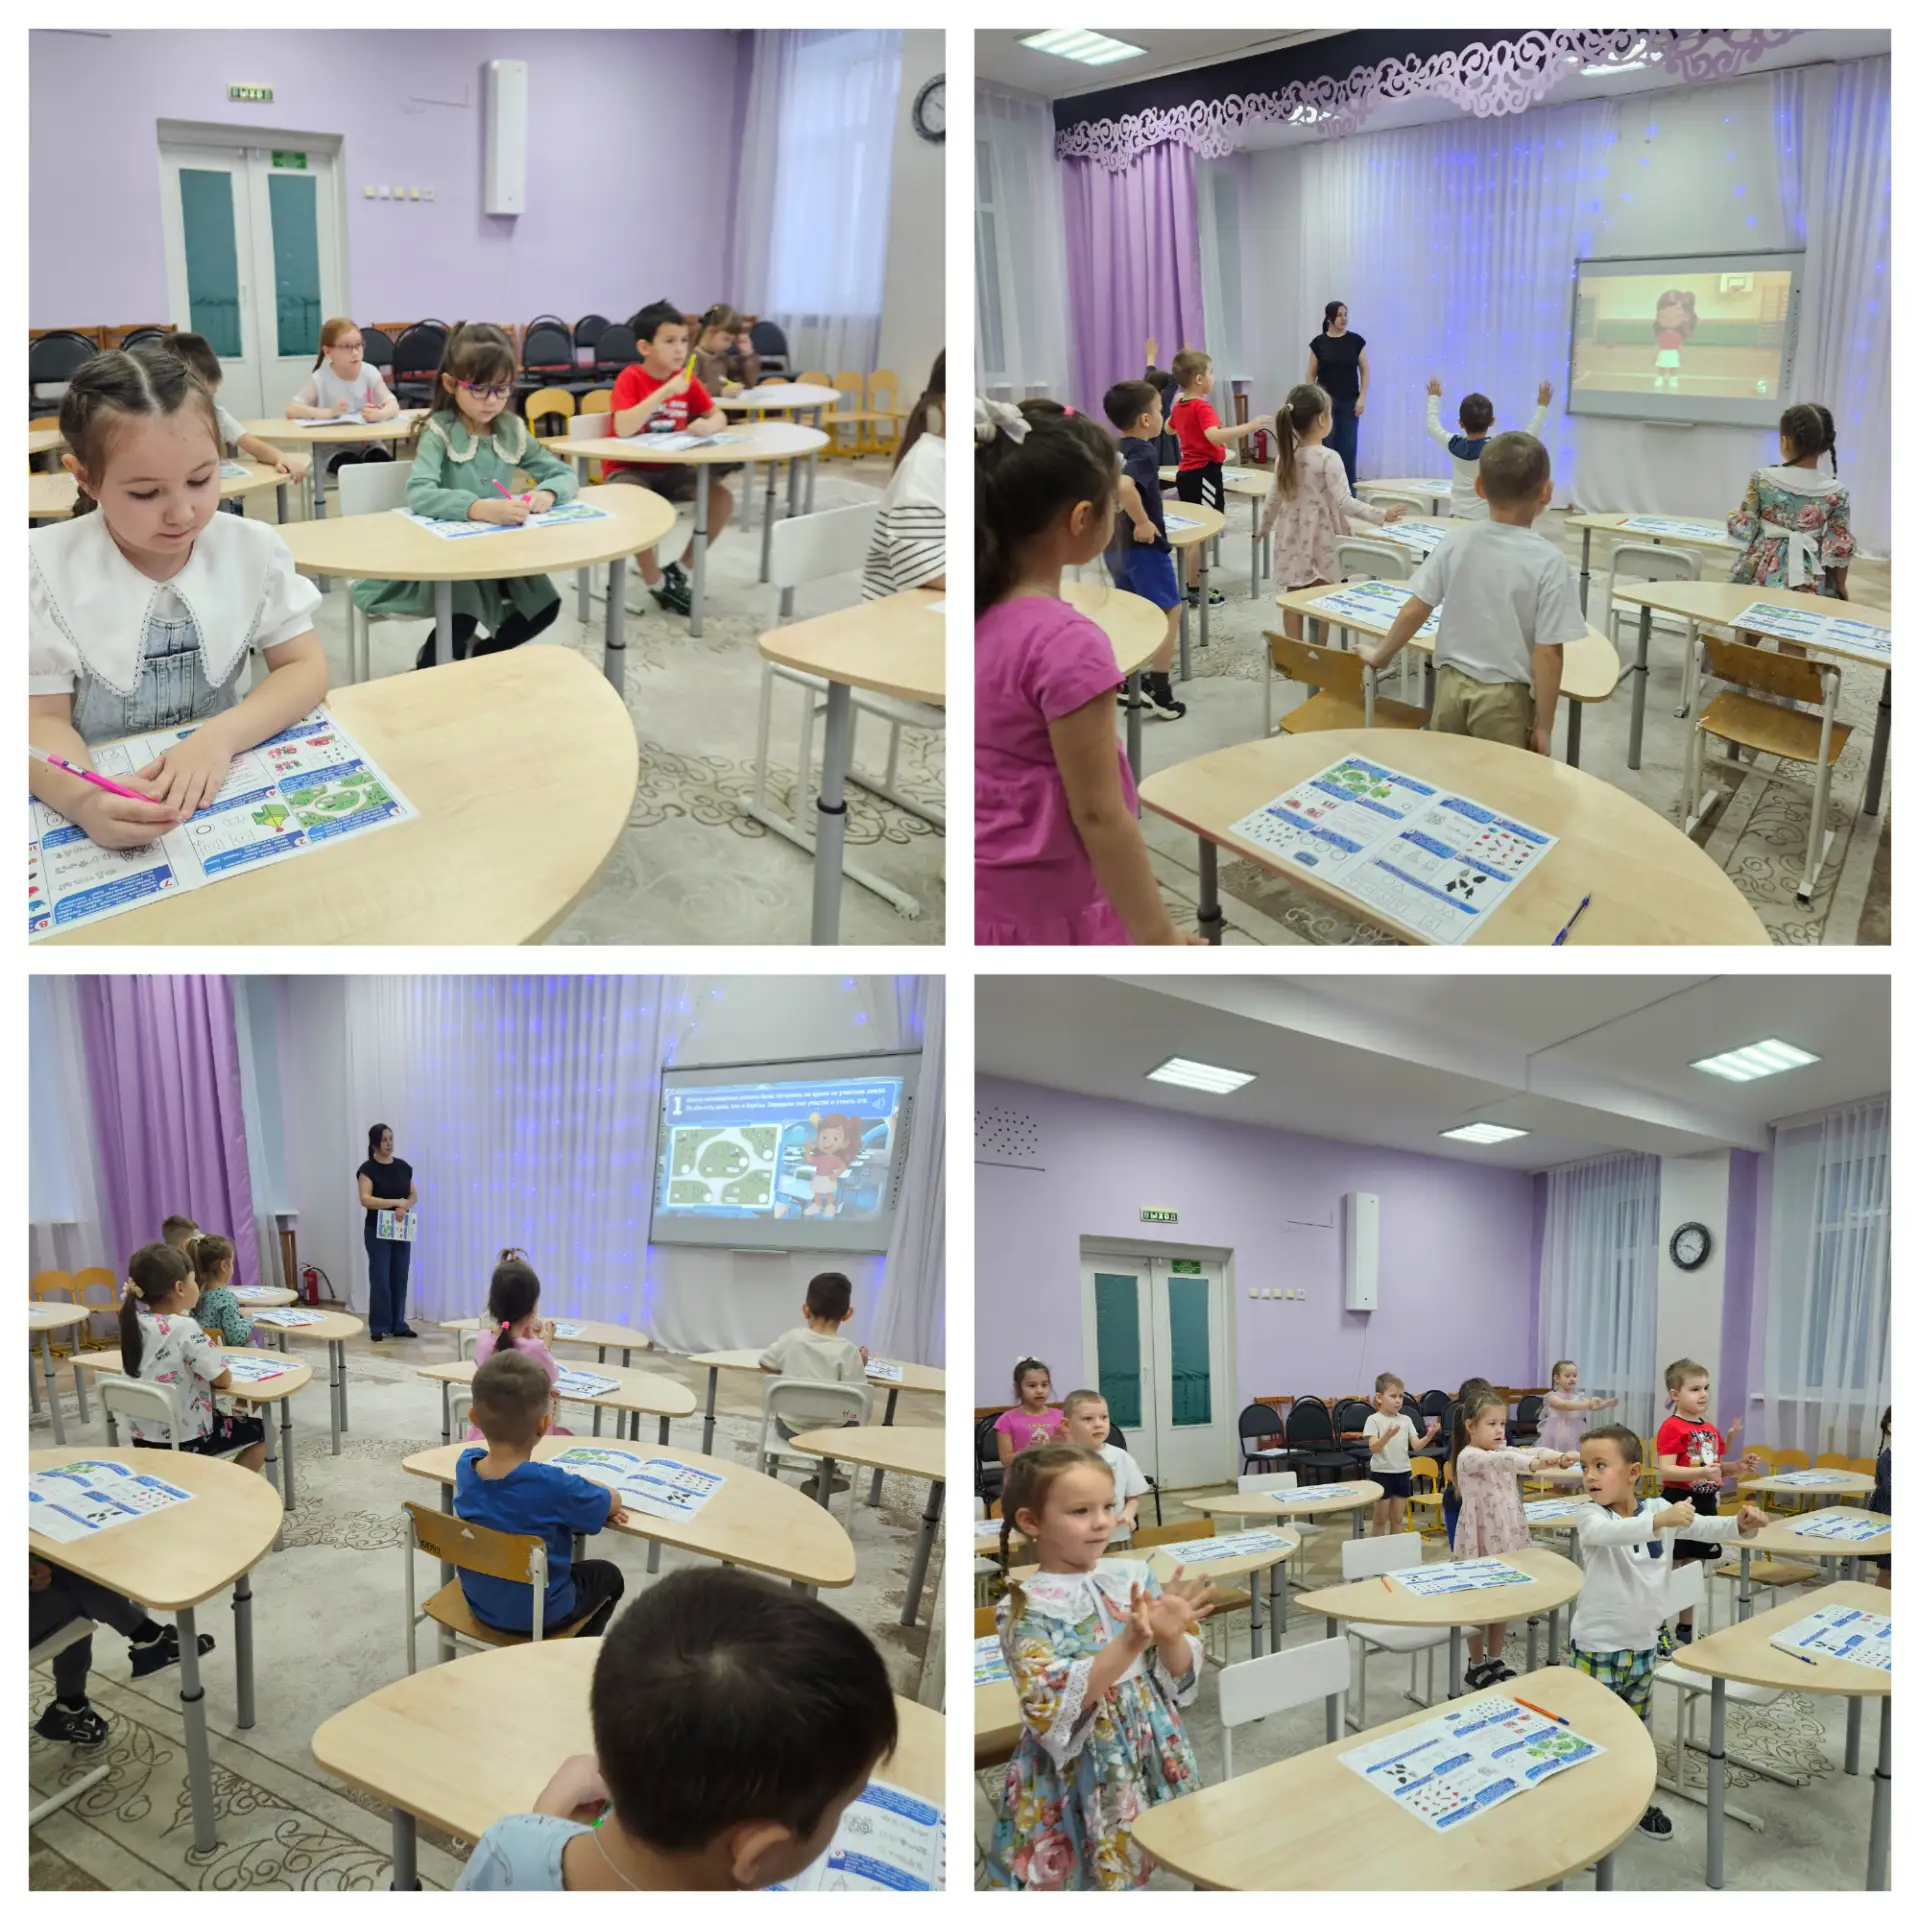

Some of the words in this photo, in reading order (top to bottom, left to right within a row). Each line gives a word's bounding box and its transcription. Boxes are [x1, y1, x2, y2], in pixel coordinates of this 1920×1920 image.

[163, 879, 173, 888] 7
[38, 919, 49, 929] 8
[672, 1095, 682, 1115] 1
[1144, 1211, 1176, 1221] ВЫХОД
